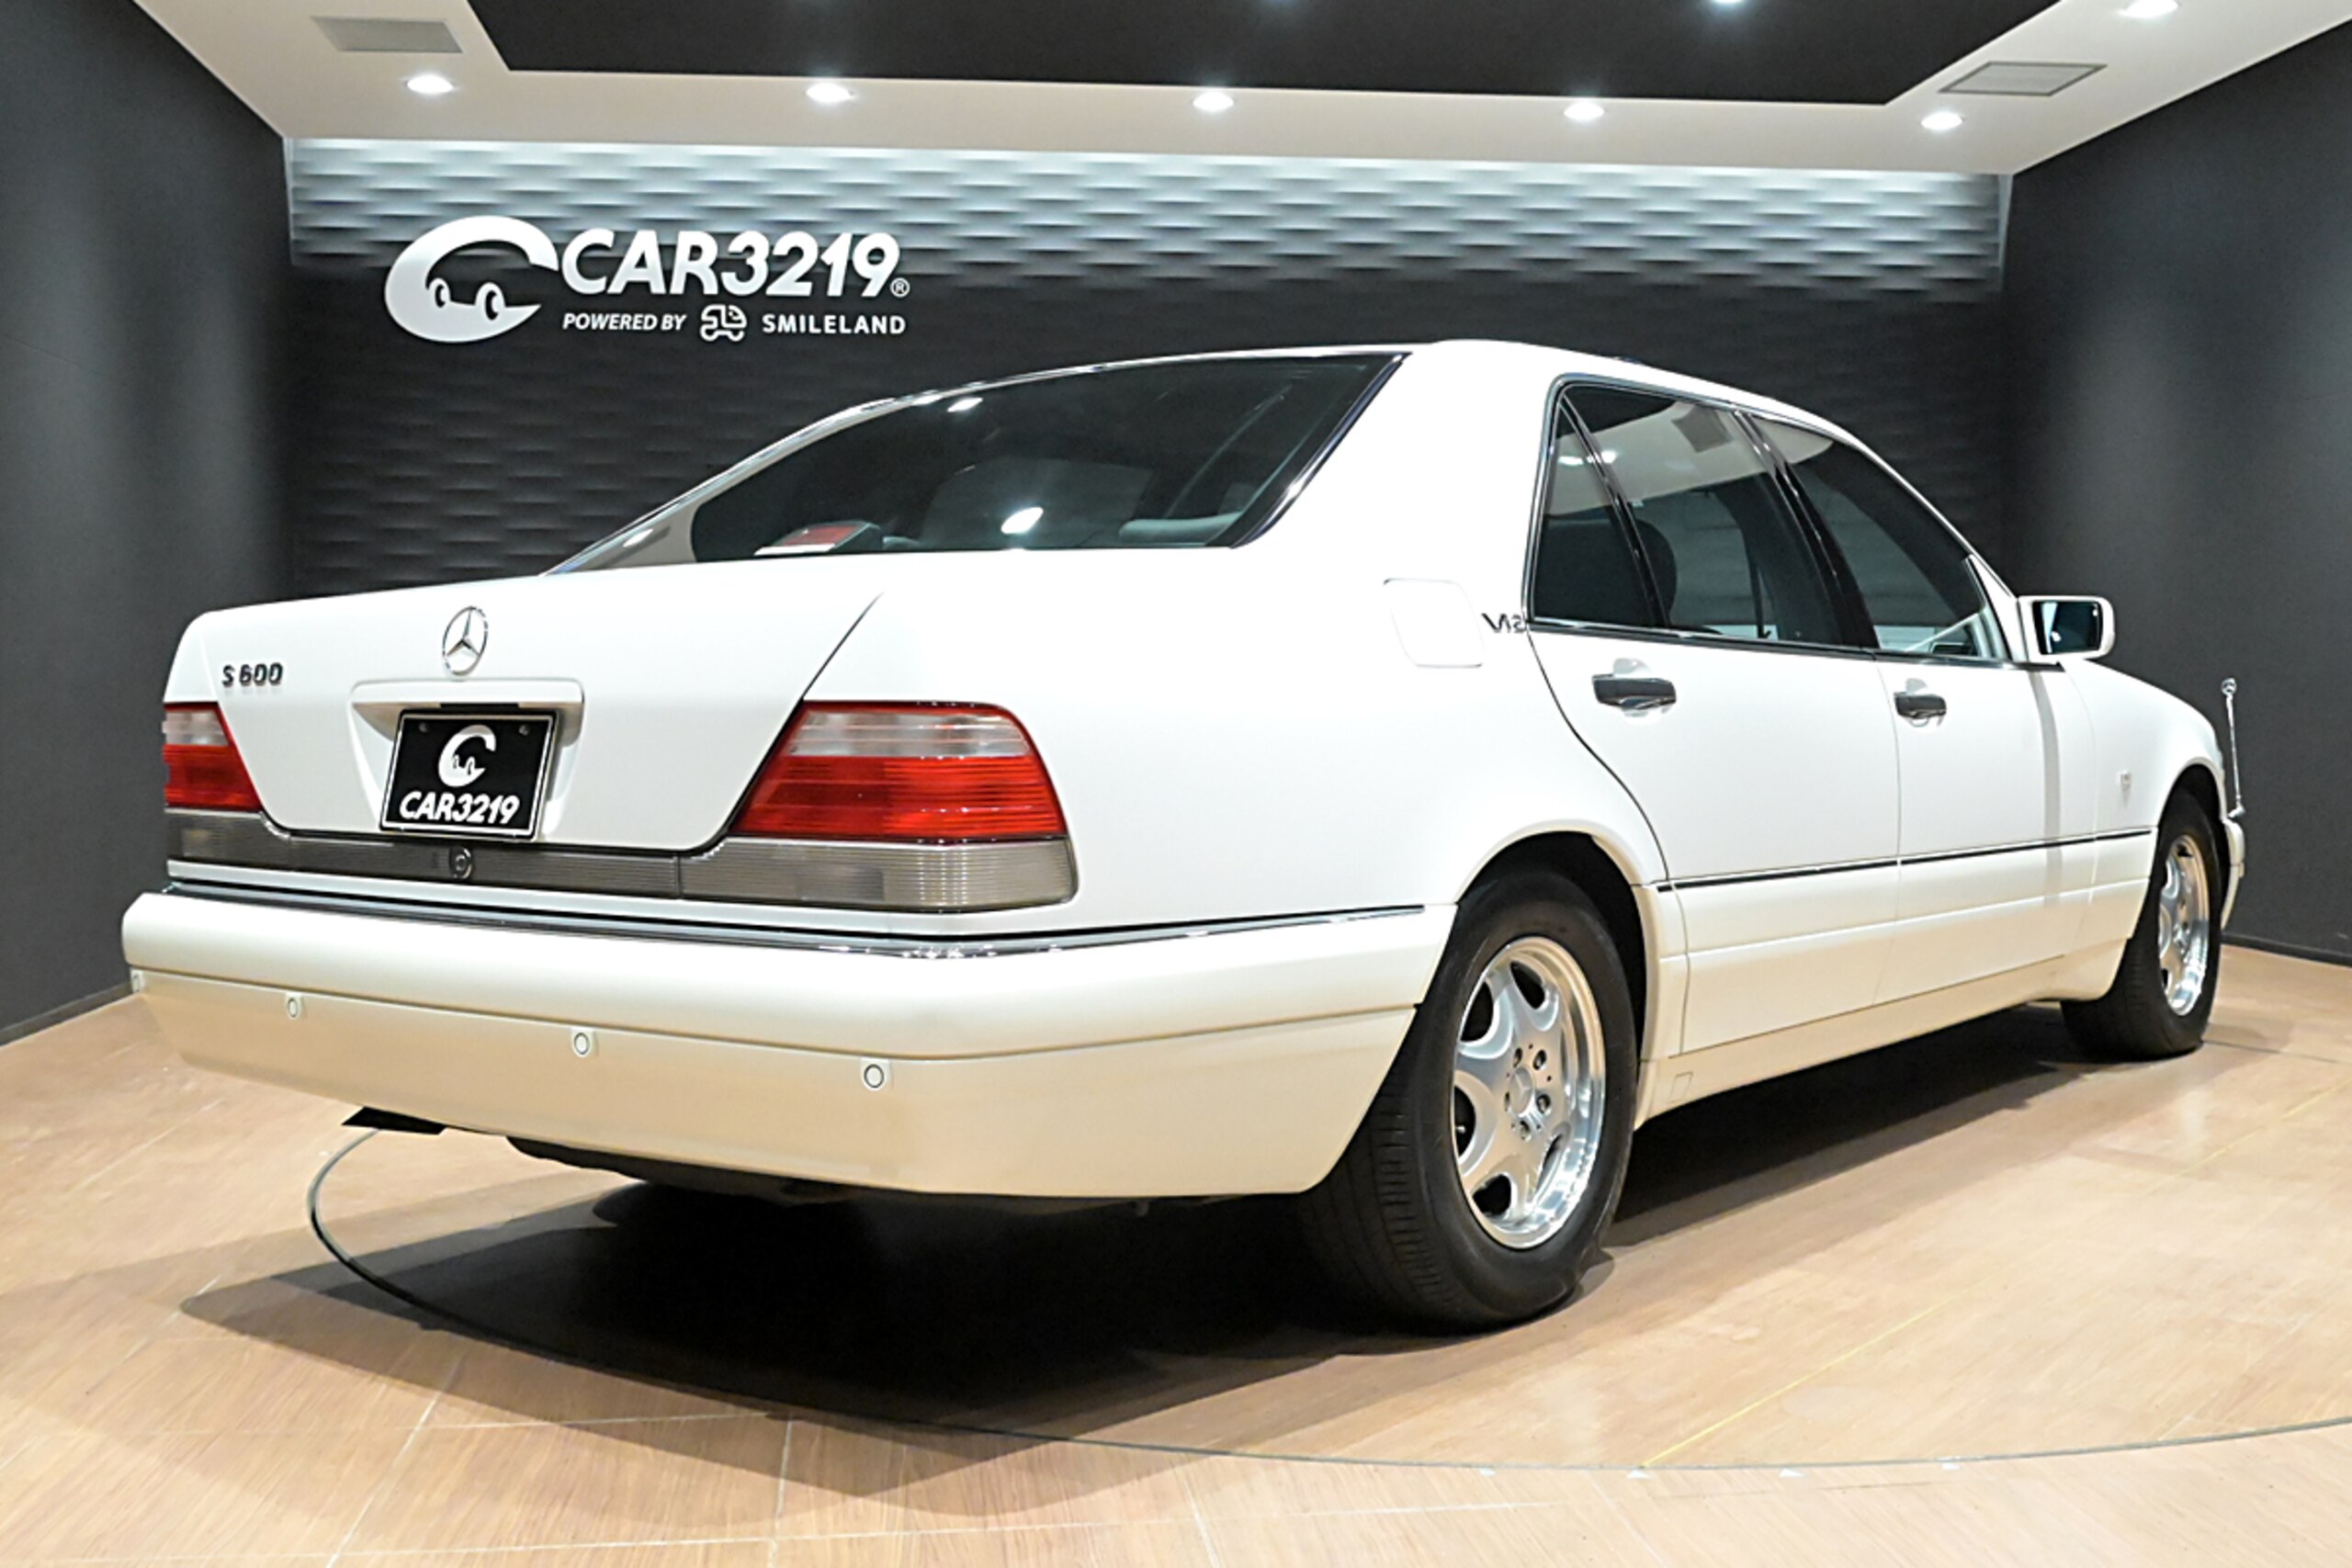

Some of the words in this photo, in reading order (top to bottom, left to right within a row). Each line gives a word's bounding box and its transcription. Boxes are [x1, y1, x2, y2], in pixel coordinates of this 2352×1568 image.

[562, 313, 657, 331] POWERED
[662, 314, 687, 332] BY
[762, 314, 906, 334] SMILELAND
[221, 664, 235, 688] S
[239, 662, 283, 687] 600
[399, 791, 520, 824] CAR3219
